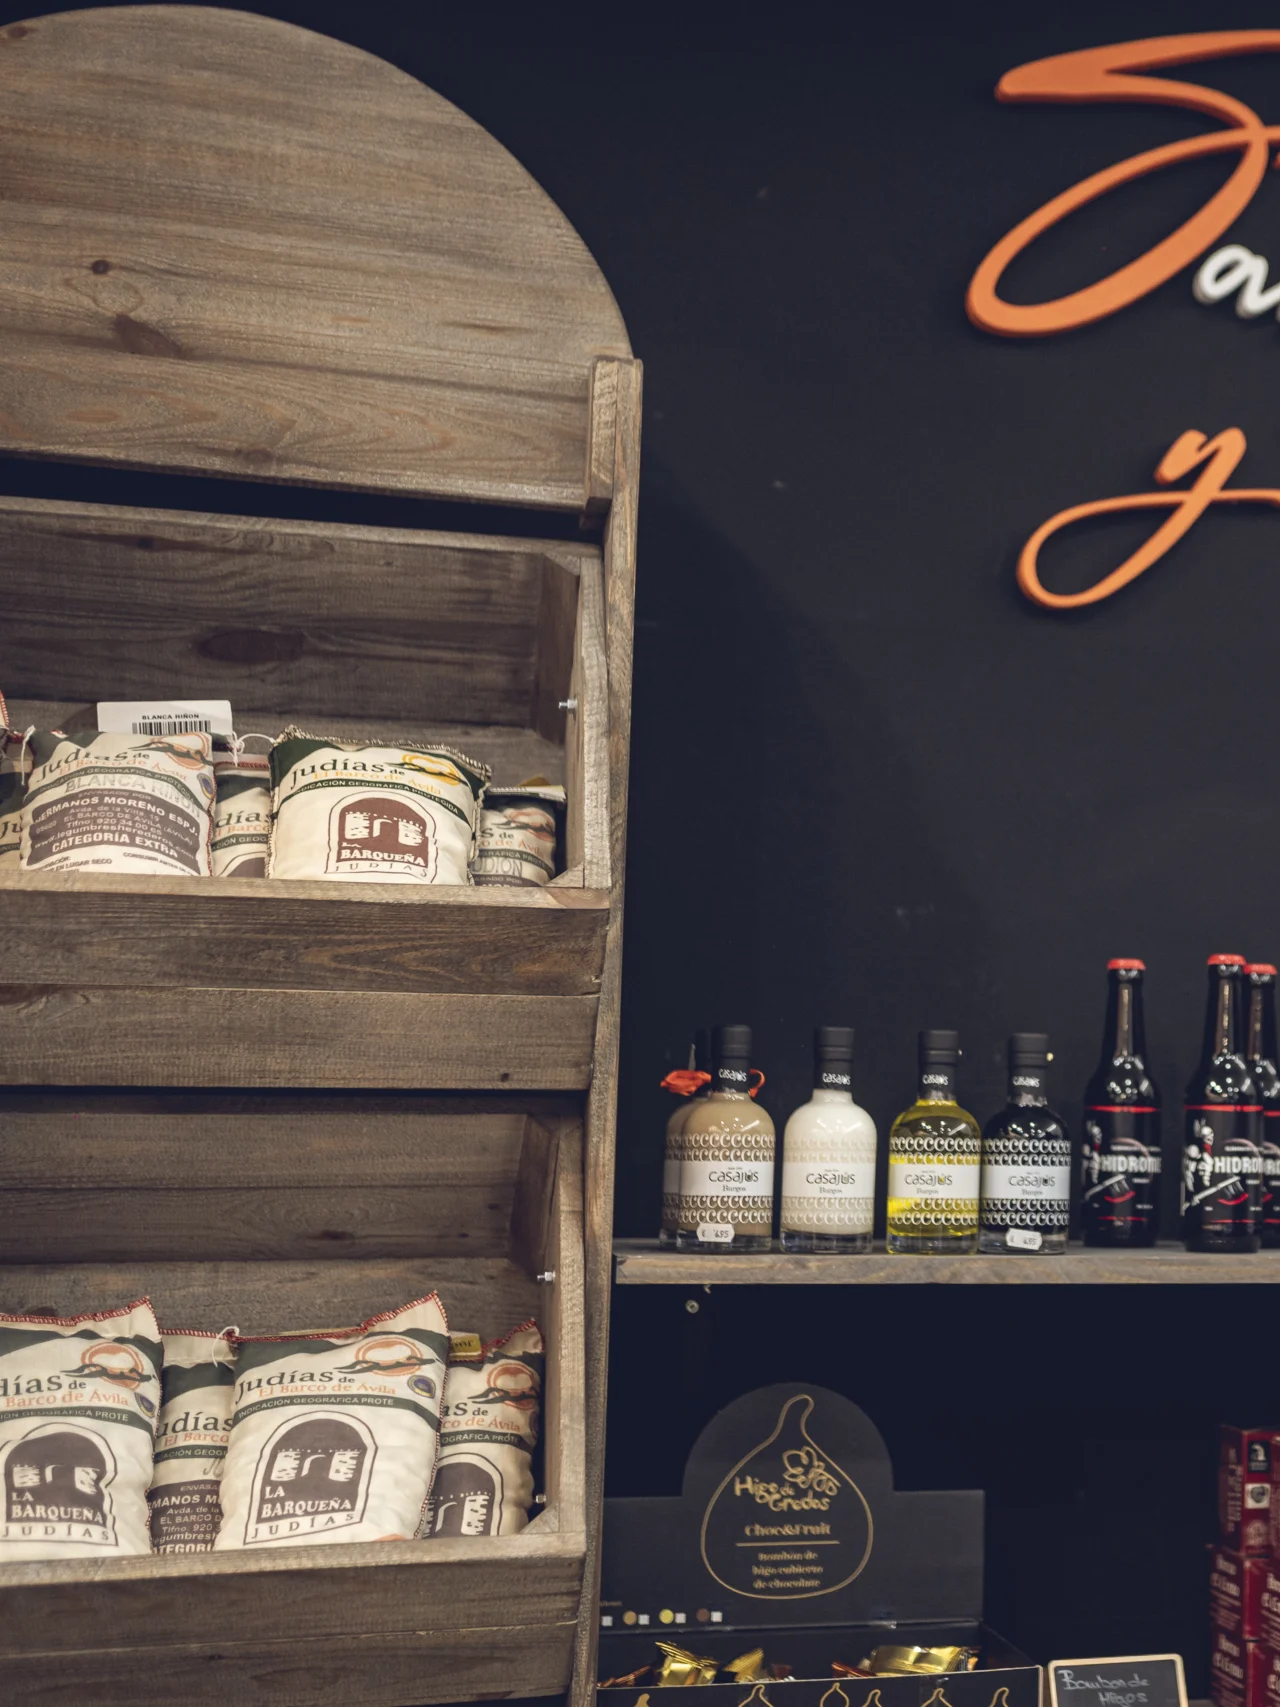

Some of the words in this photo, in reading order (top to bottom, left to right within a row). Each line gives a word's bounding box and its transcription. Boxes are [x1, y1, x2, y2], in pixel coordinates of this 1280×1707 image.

[133, 752, 150, 760] de
[290, 758, 385, 791] Judías
[104, 796, 165, 816] MORENO
[64, 815, 75, 823] EL
[52, 832, 130, 853] CATEGORÍA
[134, 836, 178, 858] EXTRA
[340, 849, 426, 867] BARQUEÑA
[68, 1380, 87, 1390] de
[234, 1369, 334, 1405] Judías
[338, 1376, 356, 1384] de
[258, 1385, 274, 1398] El
[280, 1383, 327, 1393] Barco
[331, 1383, 352, 1392] de
[356, 1381, 396, 1396] Ávila
[5, 1394, 57, 1408] Barco
[61, 1391, 84, 1402] de
[89, 1389, 129, 1406] Ávila
[361, 1396, 394, 1406] PROTE
[472, 1407, 489, 1417] de
[464, 1416, 485, 1427] de
[12, 1491, 34, 1502] LA
[264, 1485, 286, 1500] LA
[734, 1475, 779, 1504] Higo
[11, 1503, 103, 1523] BARQUEÑA
[260, 1497, 352, 1519] BARQUEÑA
[160, 1516, 171, 1525] EL
[175, 1514, 212, 1524] BARCO
[193, 1524, 213, 1532] 920
[251, 1513, 354, 1540] JUDÍAS
[2, 1524, 109, 1541] JUDÍAS
